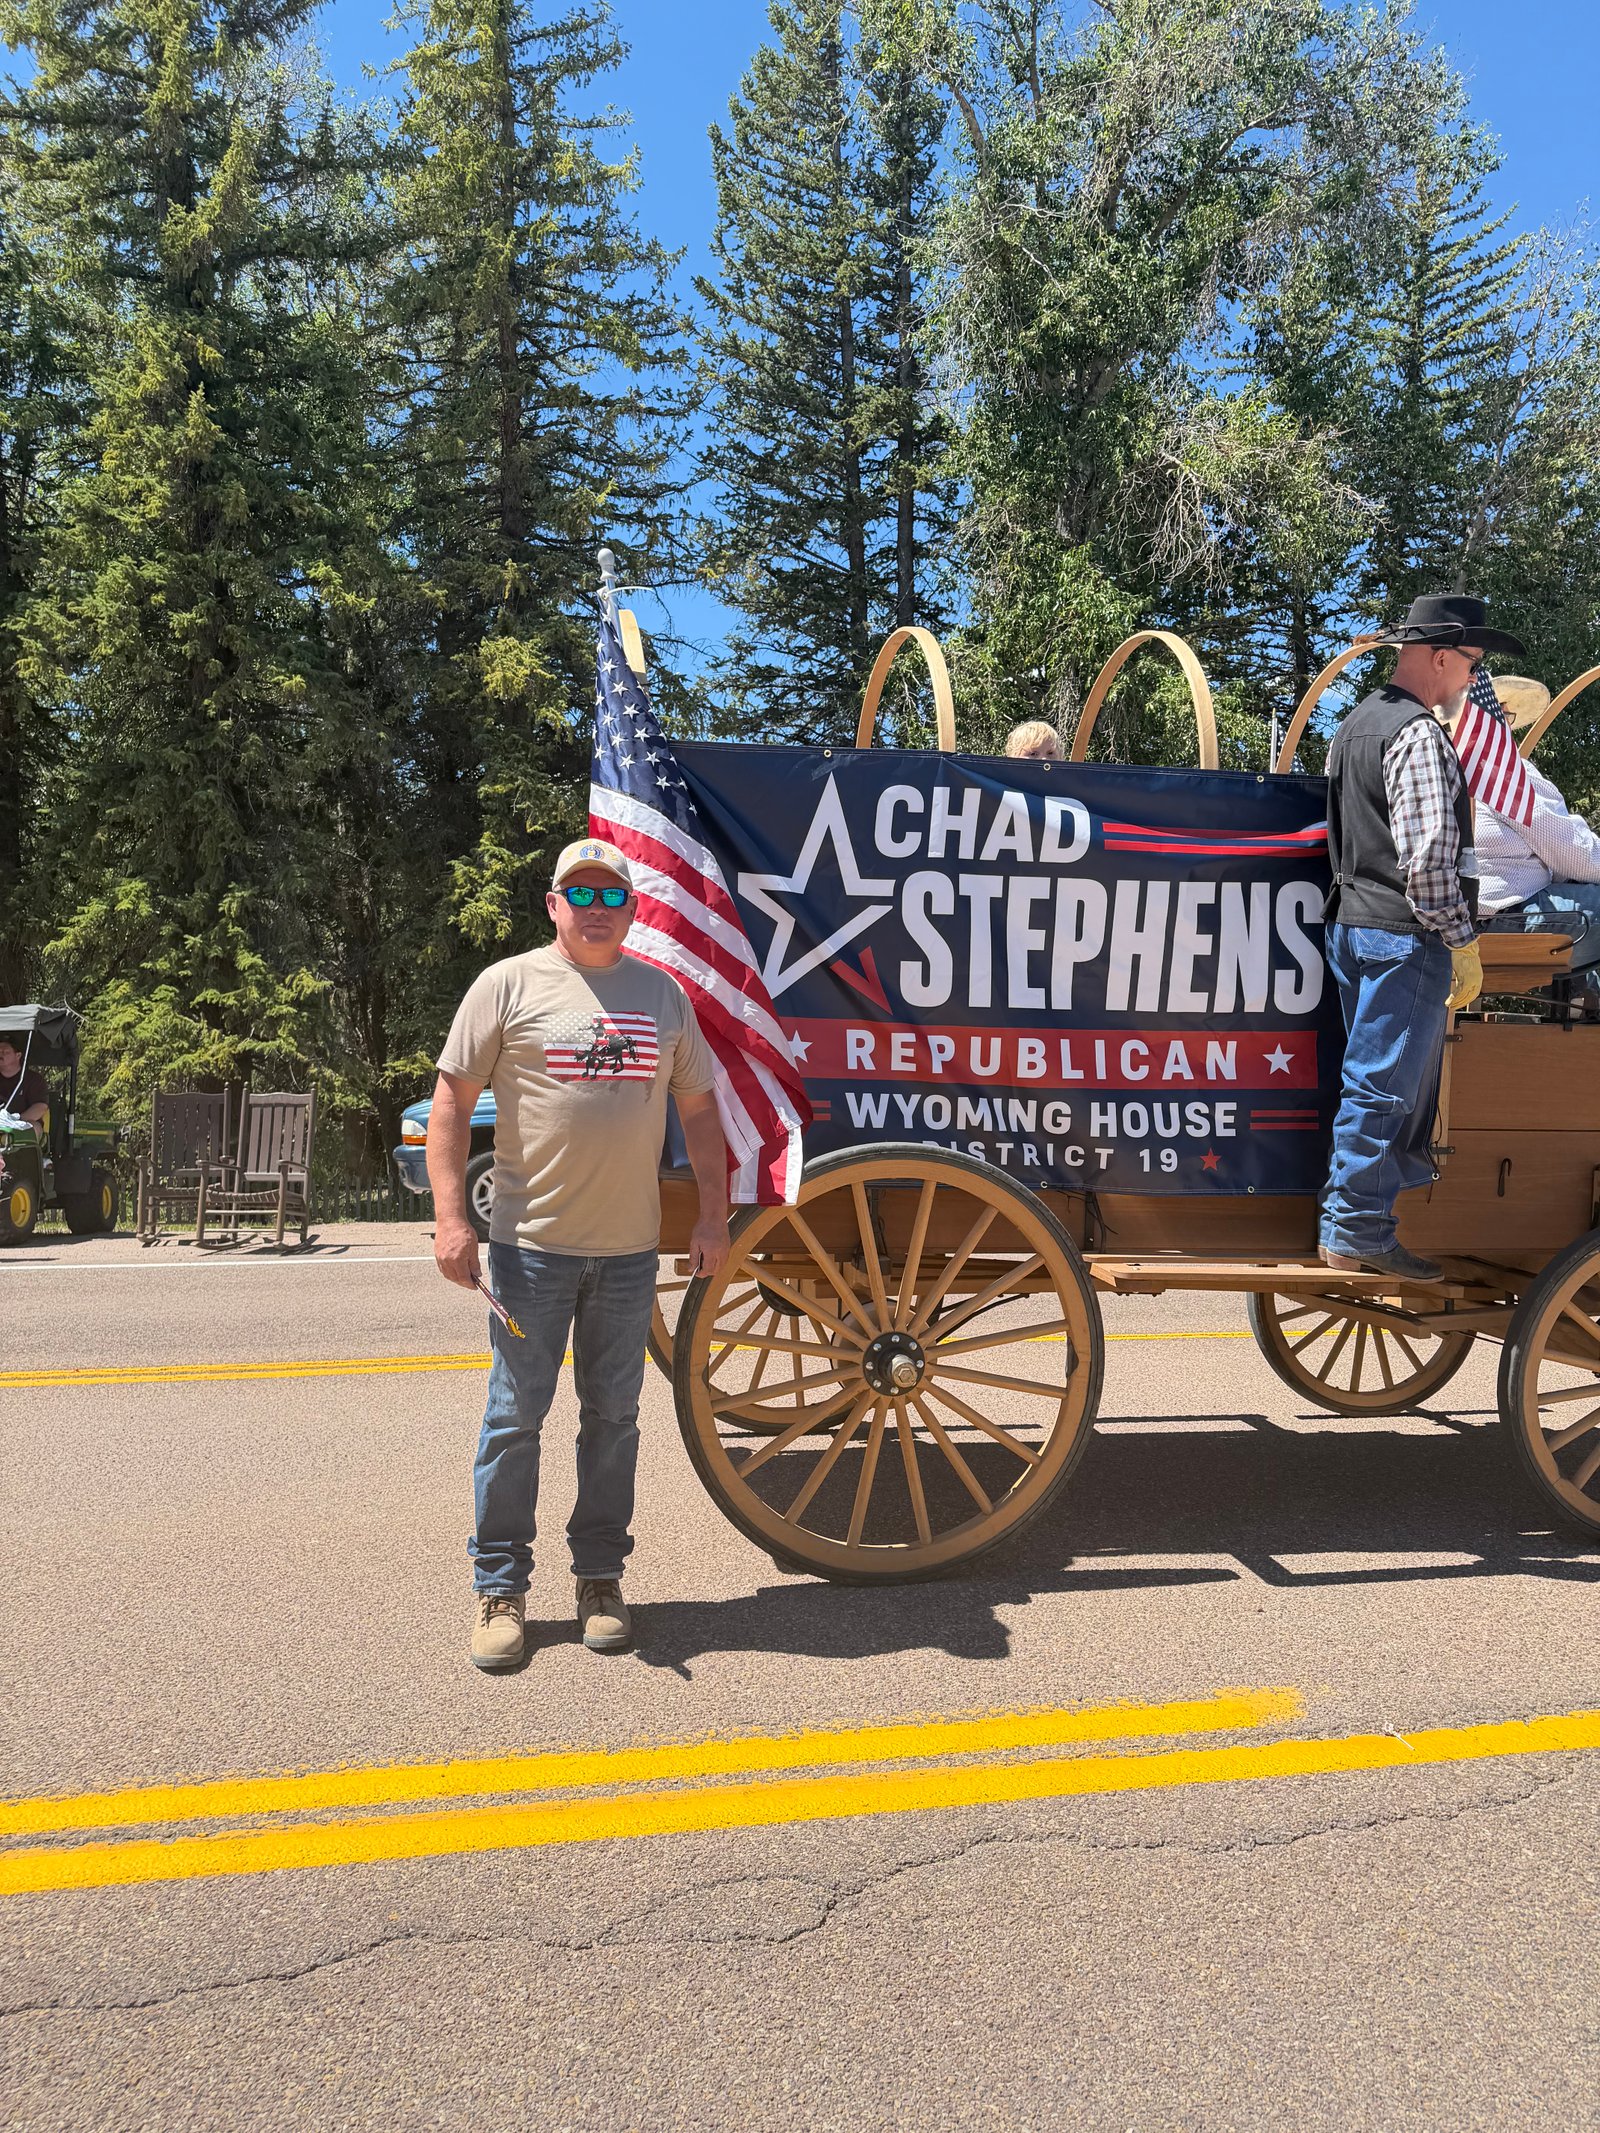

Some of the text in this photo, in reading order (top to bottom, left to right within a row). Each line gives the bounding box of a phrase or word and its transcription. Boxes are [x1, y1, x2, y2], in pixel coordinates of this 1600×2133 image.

[874, 784, 1092, 864] CHAD
[899, 870, 1325, 1015] STEPHENS
[845, 1028, 1238, 1081] REPUBLICAN
[844, 1092, 1237, 1138] WYOMING HOUSE
[922, 1140, 1179, 1173] STRICT 19
